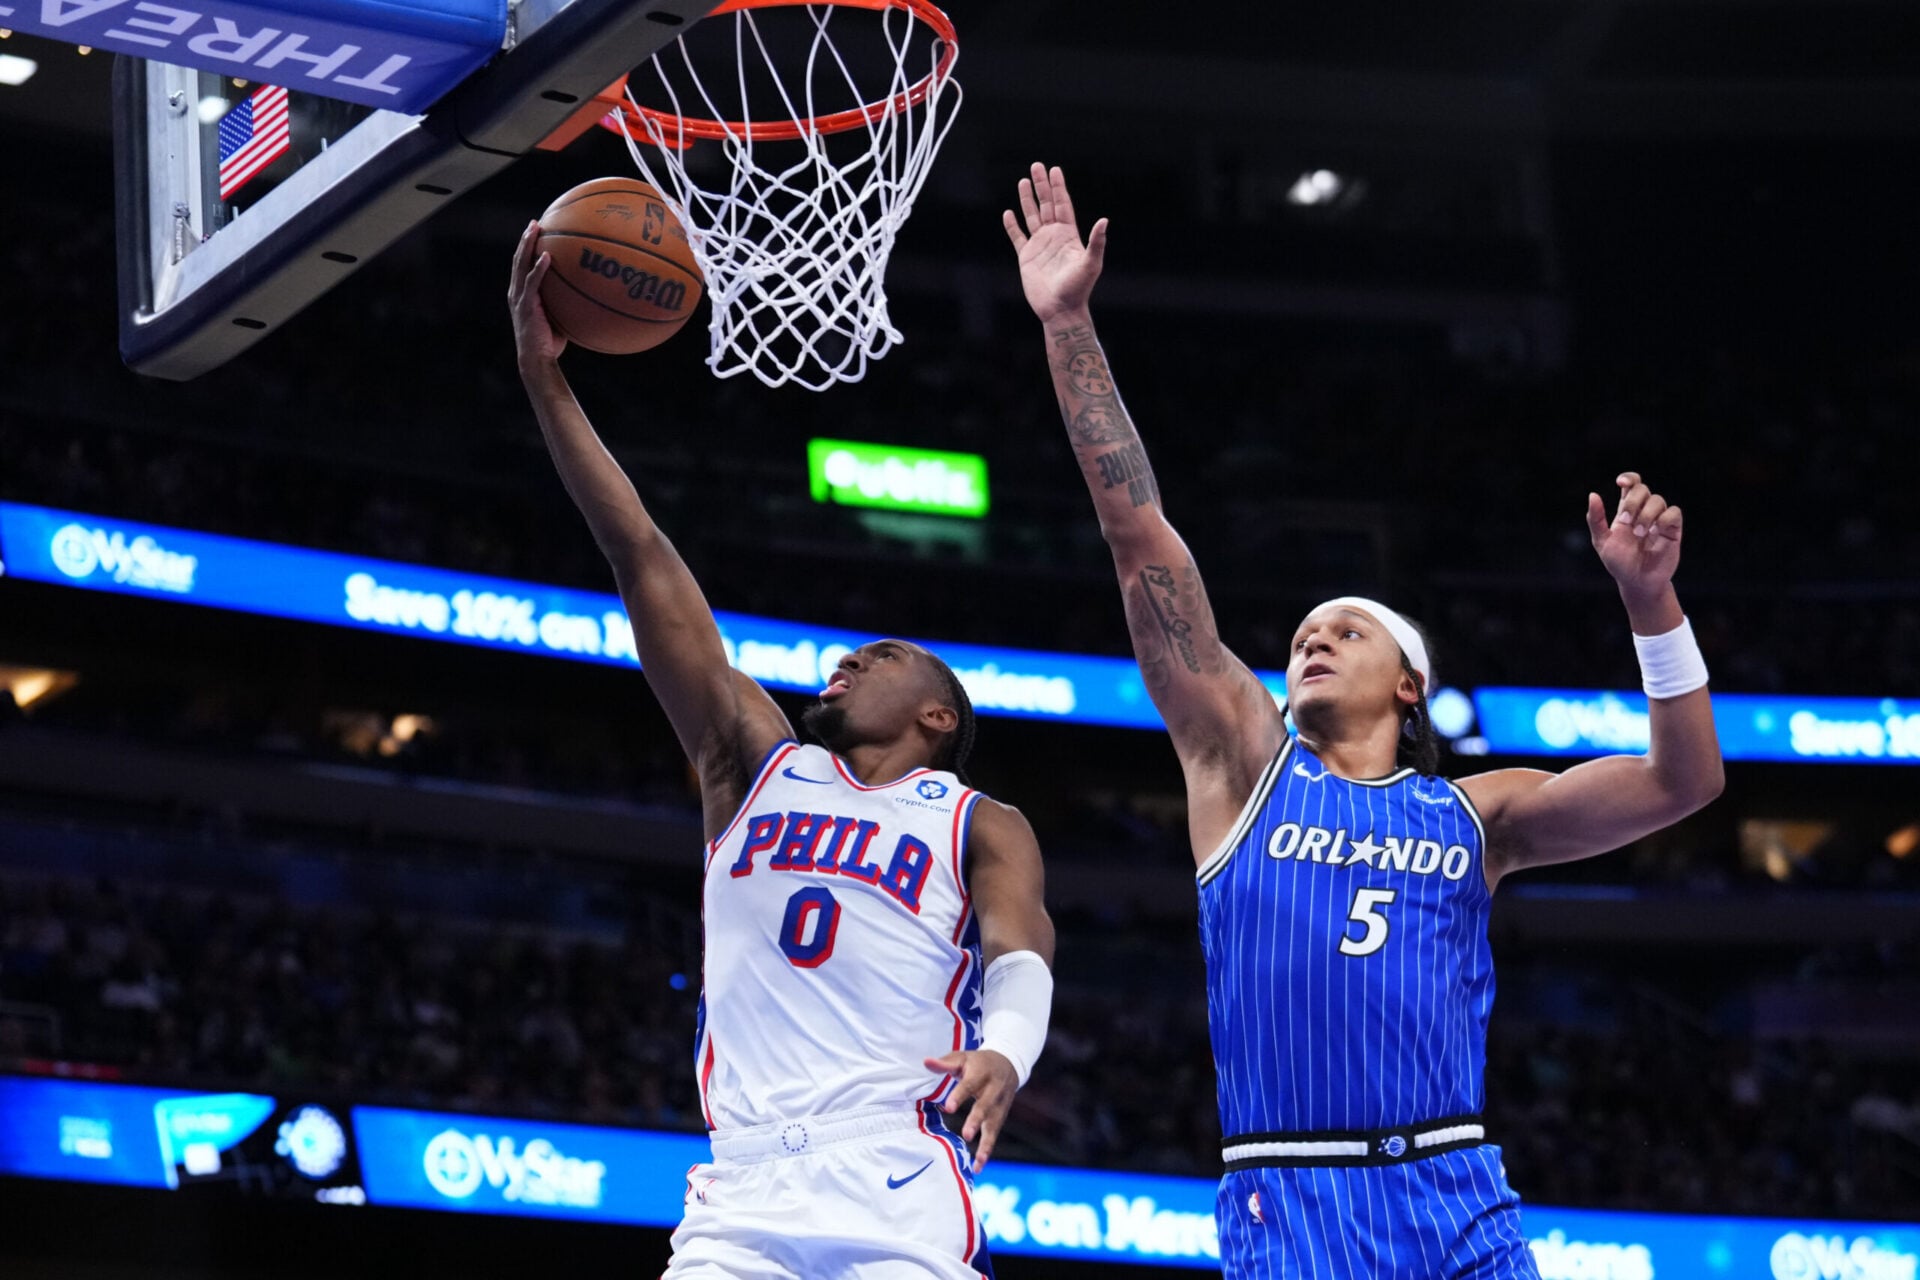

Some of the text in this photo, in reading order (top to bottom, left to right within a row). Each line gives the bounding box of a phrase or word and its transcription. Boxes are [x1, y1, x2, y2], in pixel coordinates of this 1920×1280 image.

[0, 0, 412, 95] THREA
[579, 246, 686, 311] Wilson
[452, 589, 538, 645] 10%
[895, 796, 951, 814] crypto.com
[730, 811, 933, 915] PHILA
[778, 886, 842, 968] 0
[1338, 887, 1397, 956] 5
